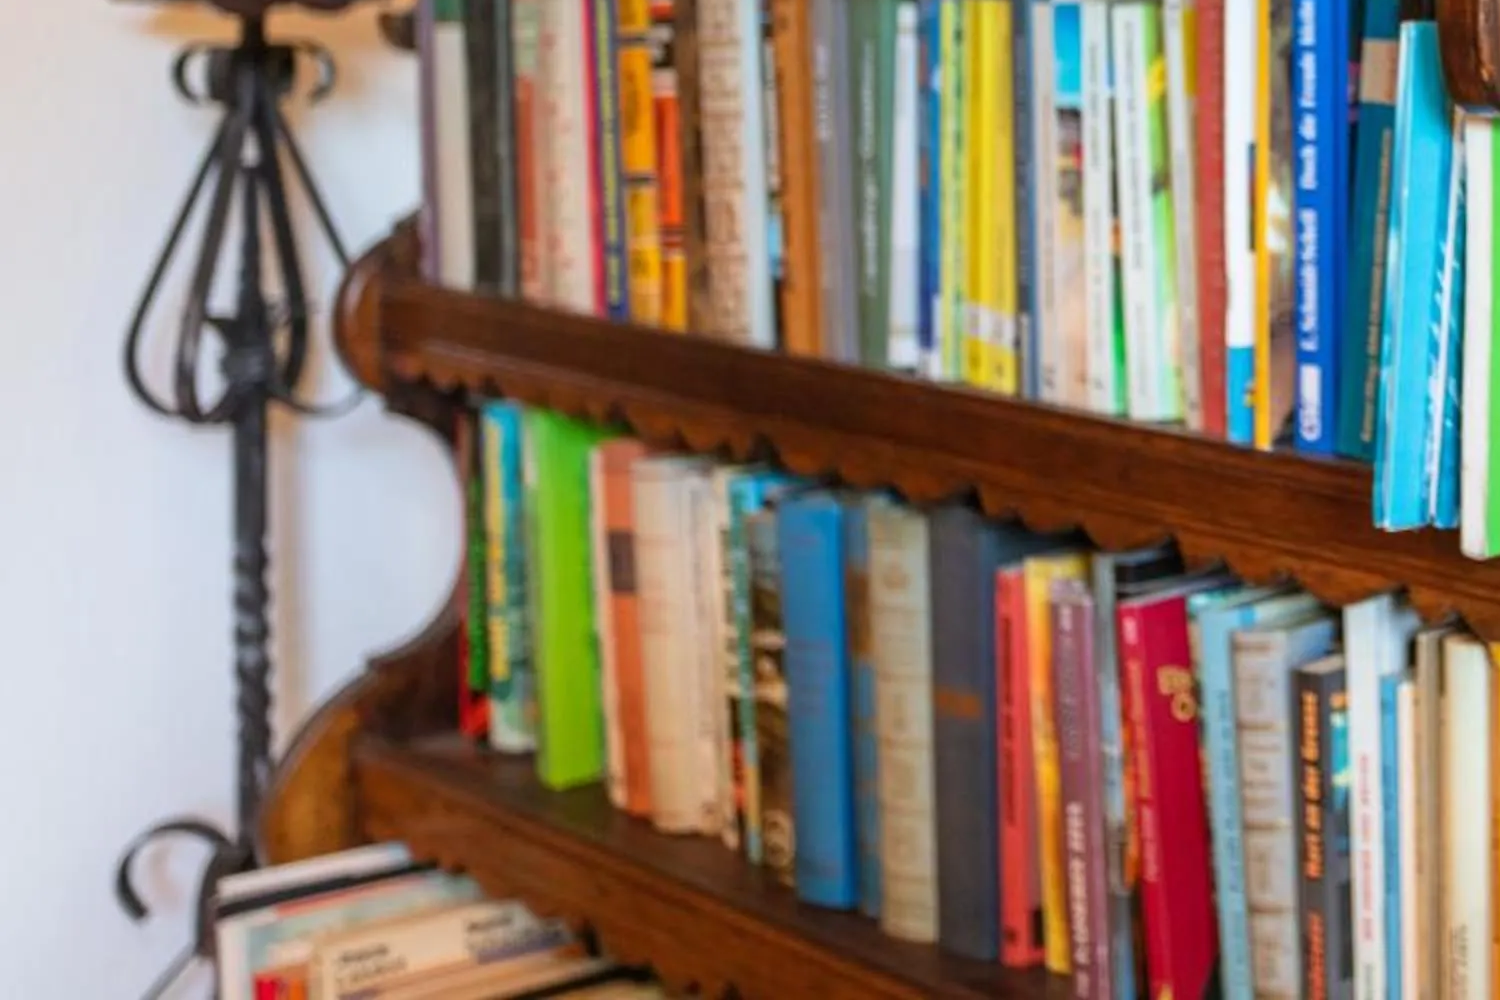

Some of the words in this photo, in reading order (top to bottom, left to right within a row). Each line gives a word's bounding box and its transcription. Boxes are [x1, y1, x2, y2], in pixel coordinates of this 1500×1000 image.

[1298, 113, 1317, 141] die
[1302, 766, 1321, 799] der
[1304, 803, 1322, 830] an
